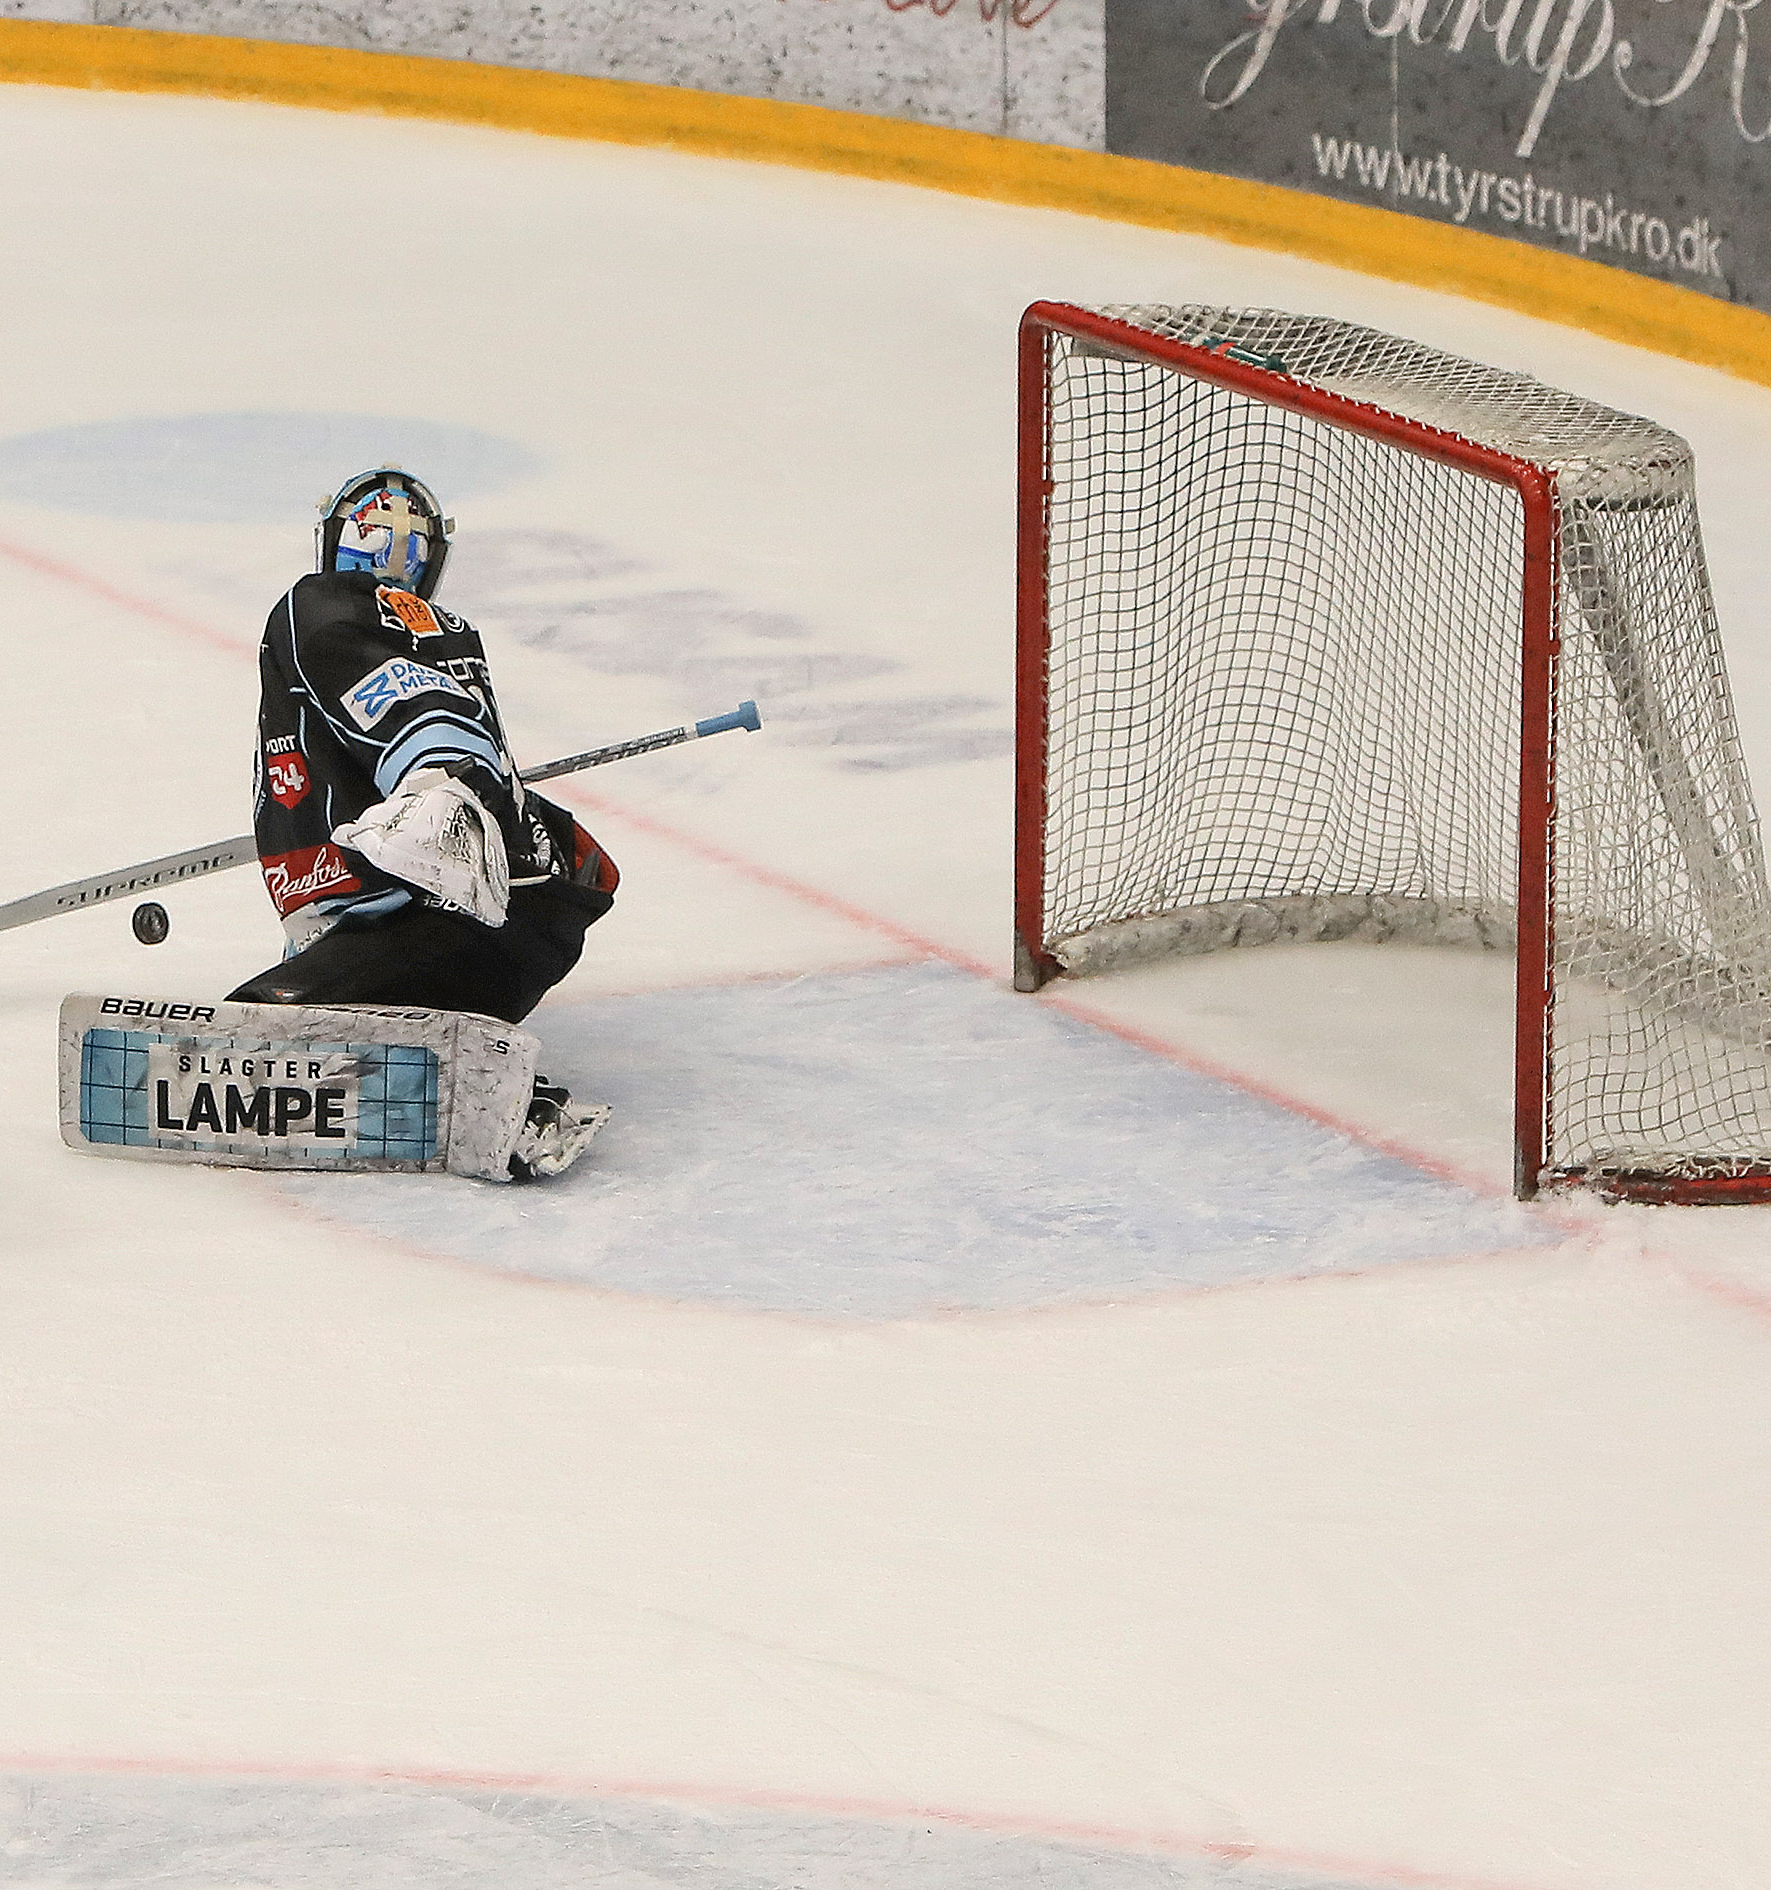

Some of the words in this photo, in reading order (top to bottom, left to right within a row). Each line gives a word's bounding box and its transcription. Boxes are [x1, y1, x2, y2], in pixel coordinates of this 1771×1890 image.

[1311, 131, 1727, 278] www.tyrstrupkro.dk
[268, 762, 305, 796] 24
[100, 998, 217, 1023] BAUER
[178, 1055, 324, 1081] SLAGTER
[157, 1079, 347, 1139] LAMPE
